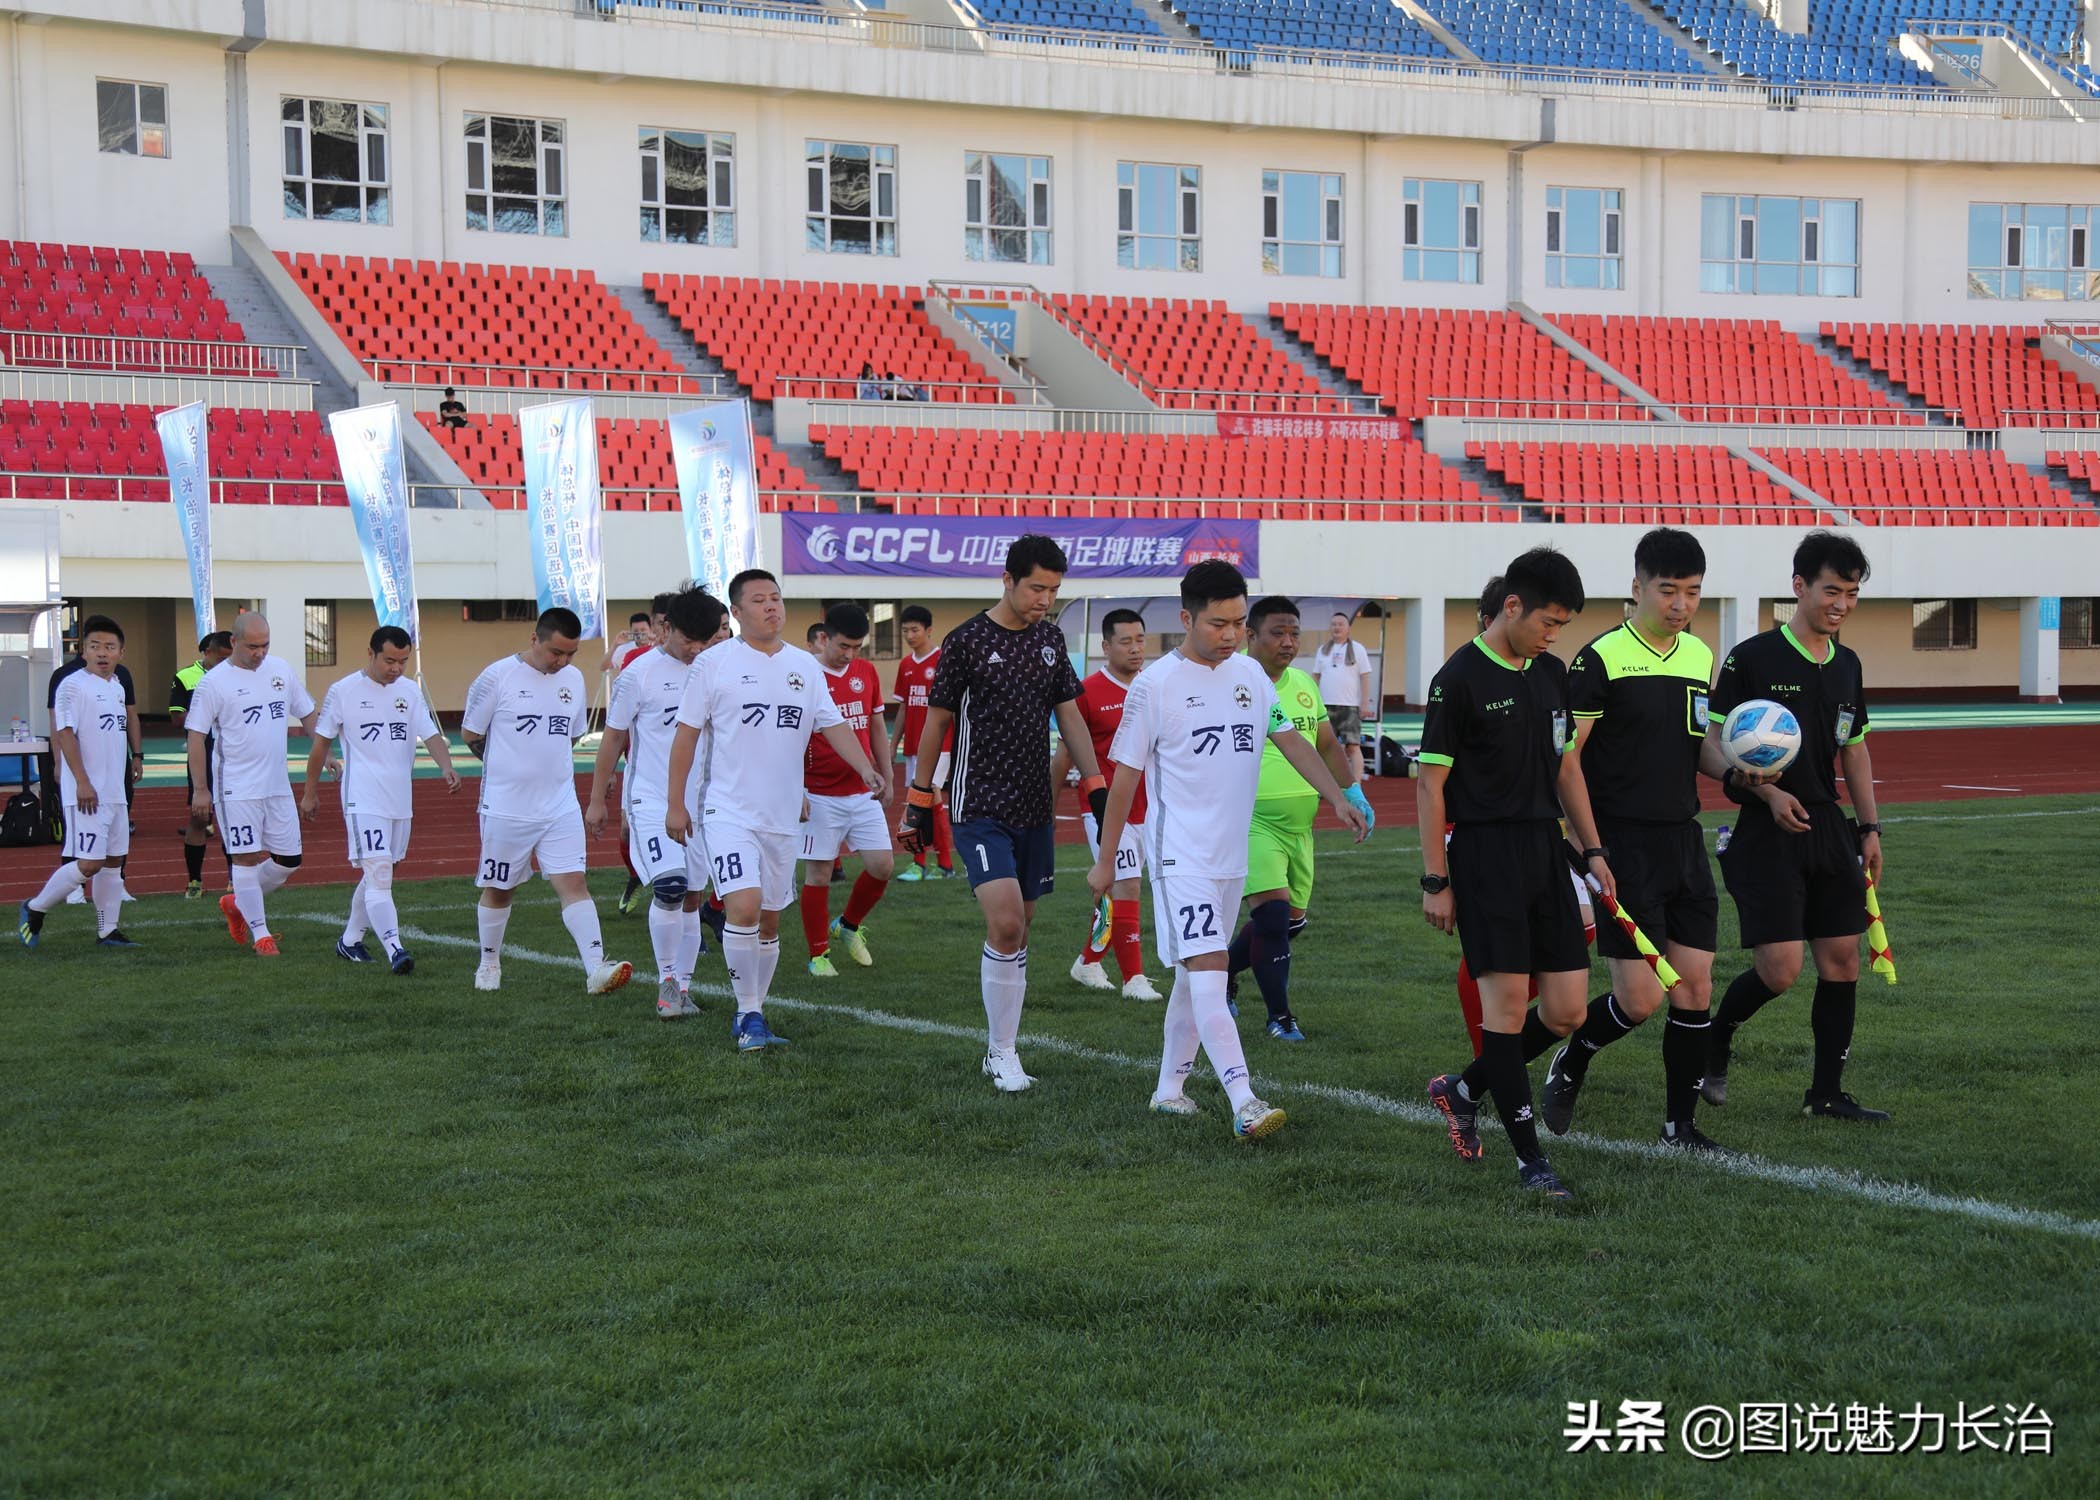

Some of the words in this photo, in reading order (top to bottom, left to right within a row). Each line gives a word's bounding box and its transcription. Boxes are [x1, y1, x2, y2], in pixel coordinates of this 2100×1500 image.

[845, 526, 954, 564] CCFL
[1771, 684, 1801, 692] KELME
[243, 701, 285, 724] 万图
[1486, 698, 1515, 711] KELME
[515, 714, 571, 737] 万图
[741, 703, 803, 730] 万图
[360, 722, 408, 742] 万图
[1191, 723, 1254, 756] 万图
[78, 832, 97, 853] 17
[230, 825, 254, 847] 33
[364, 829, 385, 851] 12
[803, 834, 814, 855] 11
[648, 836, 663, 863] 9
[975, 844, 990, 872] 1
[1116, 849, 1137, 870] 20
[483, 858, 510, 882] 30
[714, 852, 743, 884] 28
[1179, 903, 1218, 940] 22
